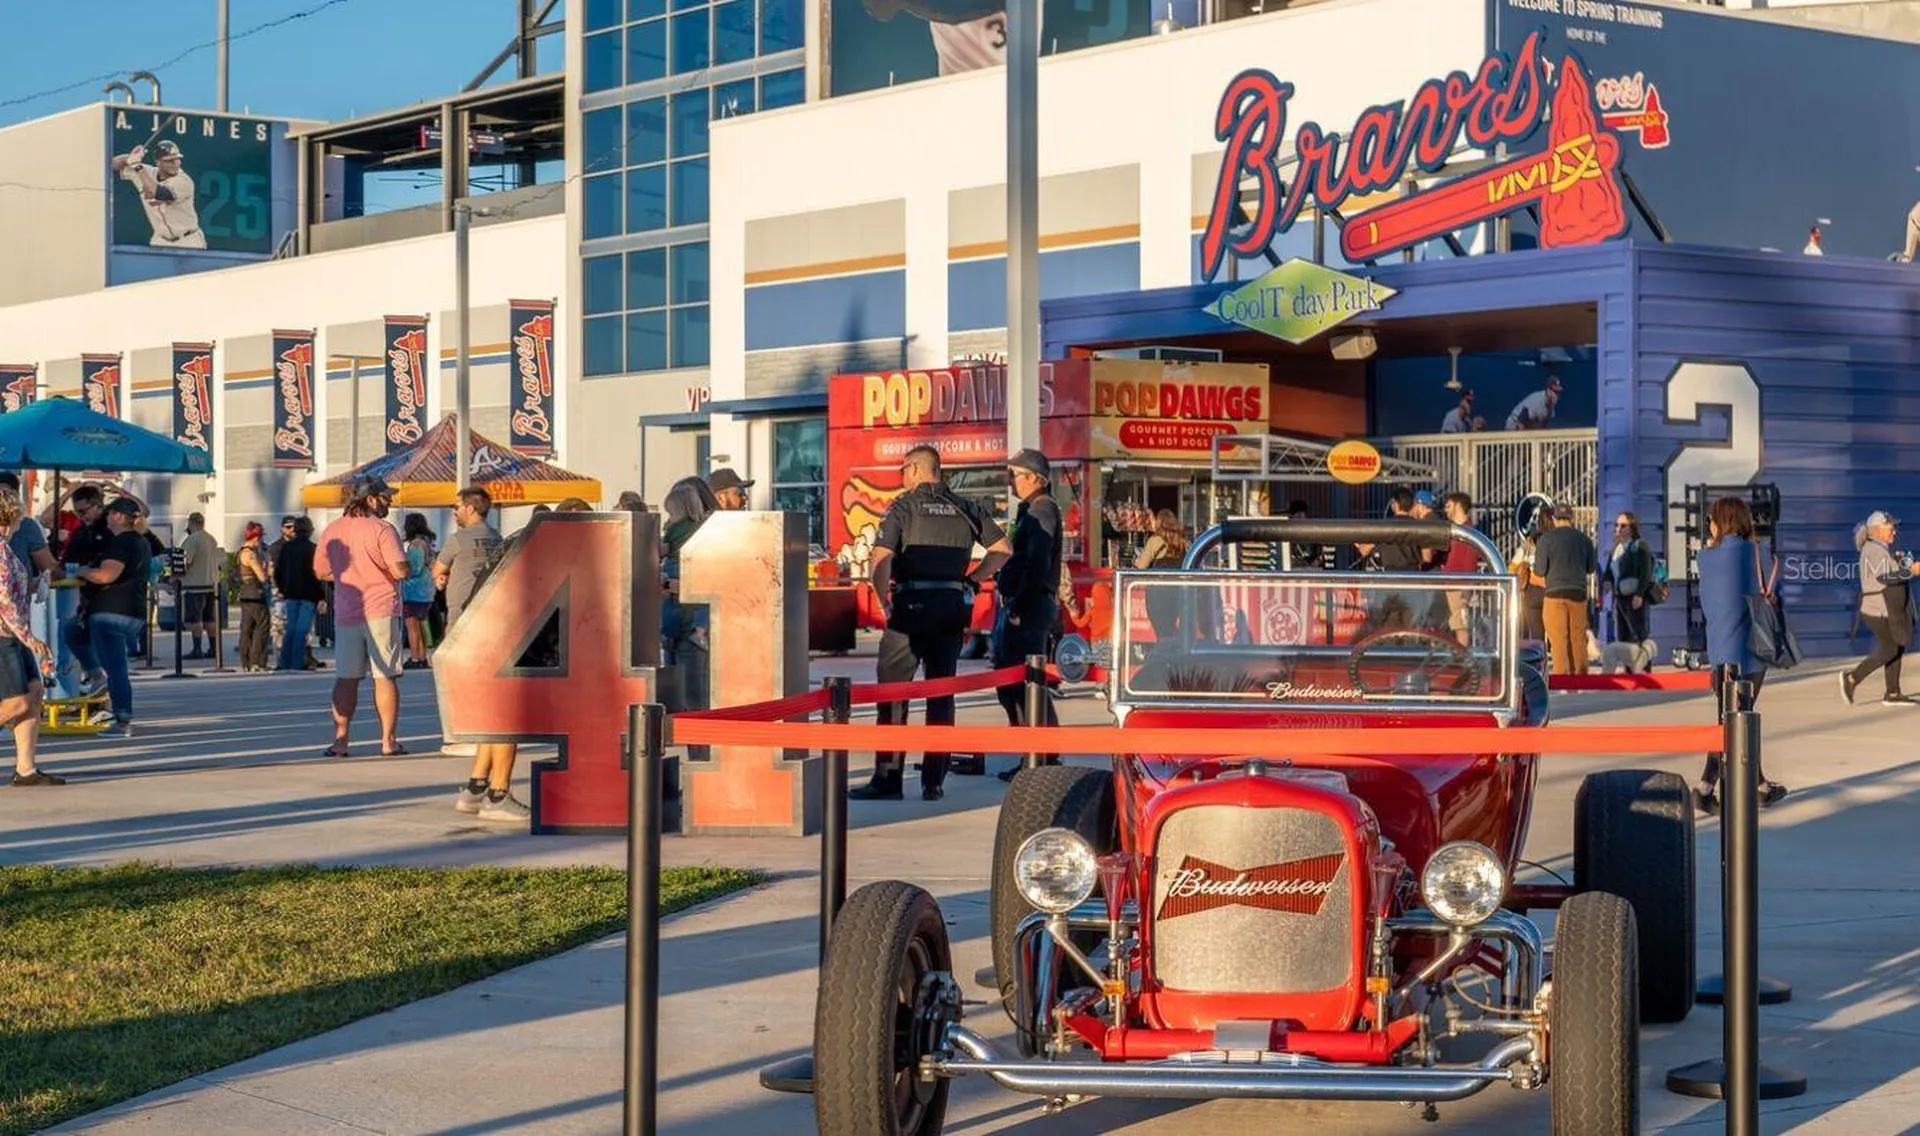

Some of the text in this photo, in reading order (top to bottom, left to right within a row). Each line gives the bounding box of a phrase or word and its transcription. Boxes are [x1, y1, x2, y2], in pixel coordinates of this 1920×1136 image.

[1563, 0, 1576, 16] TO
[1577, 1, 1615, 22] SPRING
[1616, 5, 1663, 28] TRAINING
[116, 111, 267, 141] A. JONES
[1202, 26, 1547, 281] Braves
[200, 171, 266, 240] 25
[387, 349, 423, 445] Braves
[512, 335, 550, 442] Braves
[685, 387, 710, 413] VIP
[861, 362, 1055, 429] POPDAWS
[1094, 380, 1261, 420] POPDAWGS
[275, 362, 312, 456] Braves
[1129, 425, 1228, 436] GOURMET POPCORN
[1159, 437, 1178, 446] HOT
[1182, 438, 1209, 447] DOGS
[882, 442, 925, 455] GOURM
[1663, 359, 1763, 582] 2
[1265, 682, 1362, 699] Budweiser
[1163, 867, 1333, 898] Budweiser
